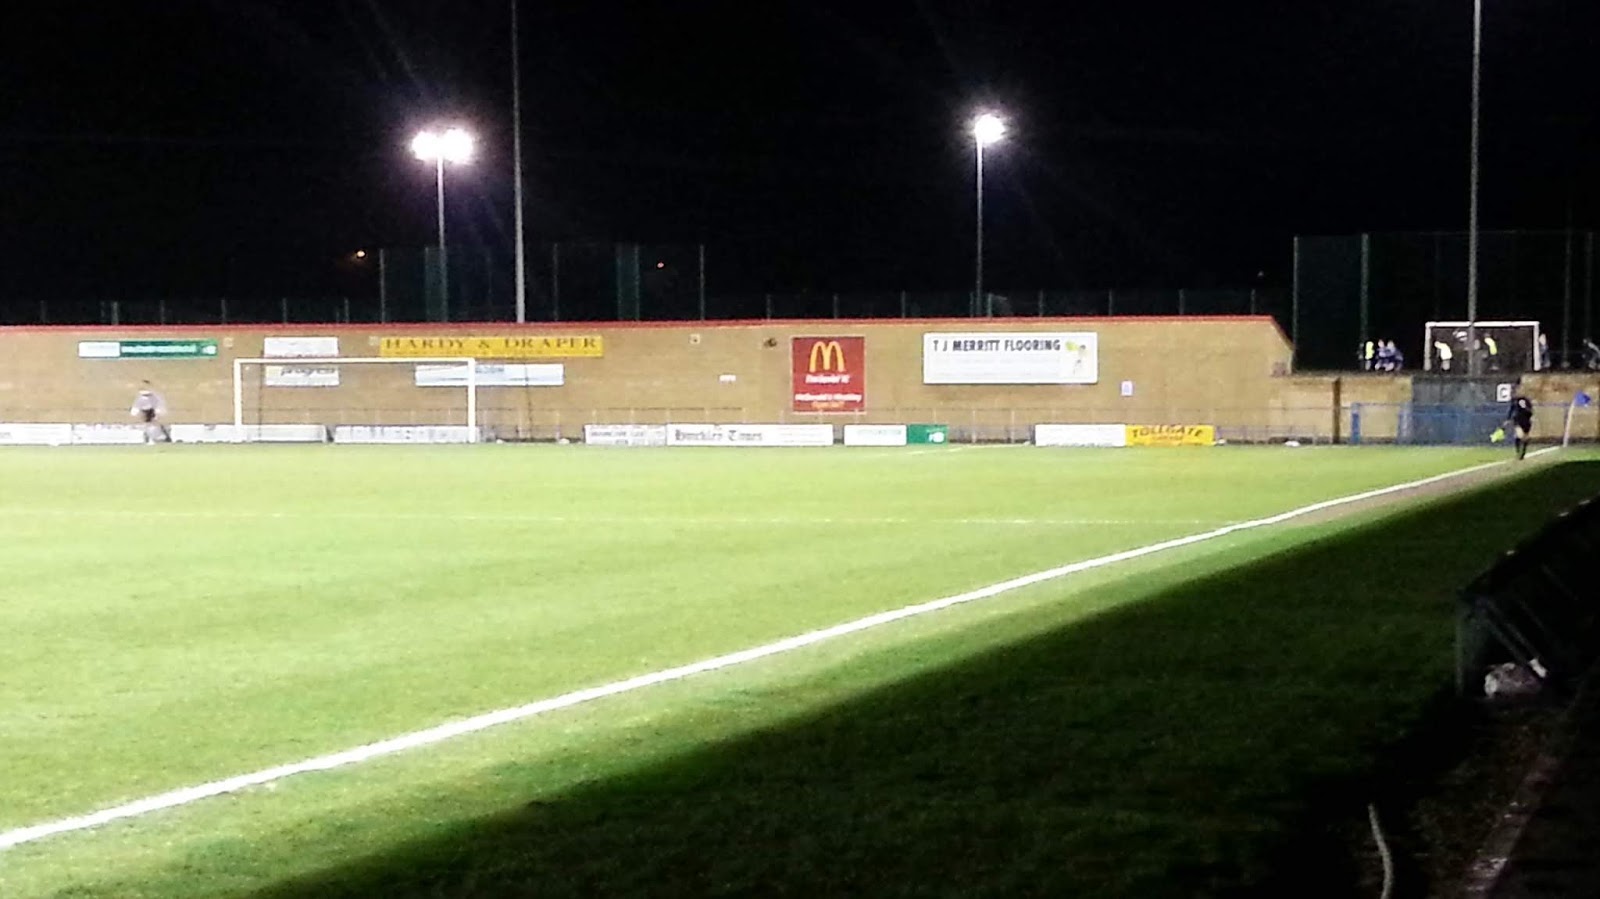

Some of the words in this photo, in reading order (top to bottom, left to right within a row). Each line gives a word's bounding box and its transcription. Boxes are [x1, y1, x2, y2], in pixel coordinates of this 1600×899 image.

[386, 337, 465, 349] HARDY
[478, 338, 490, 348] &
[505, 337, 597, 349] DRAPER
[933, 339, 939, 351] T
[942, 339, 948, 351] J
[952, 339, 1000, 351] MERRITT
[1004, 339, 1061, 351] FLOORING
